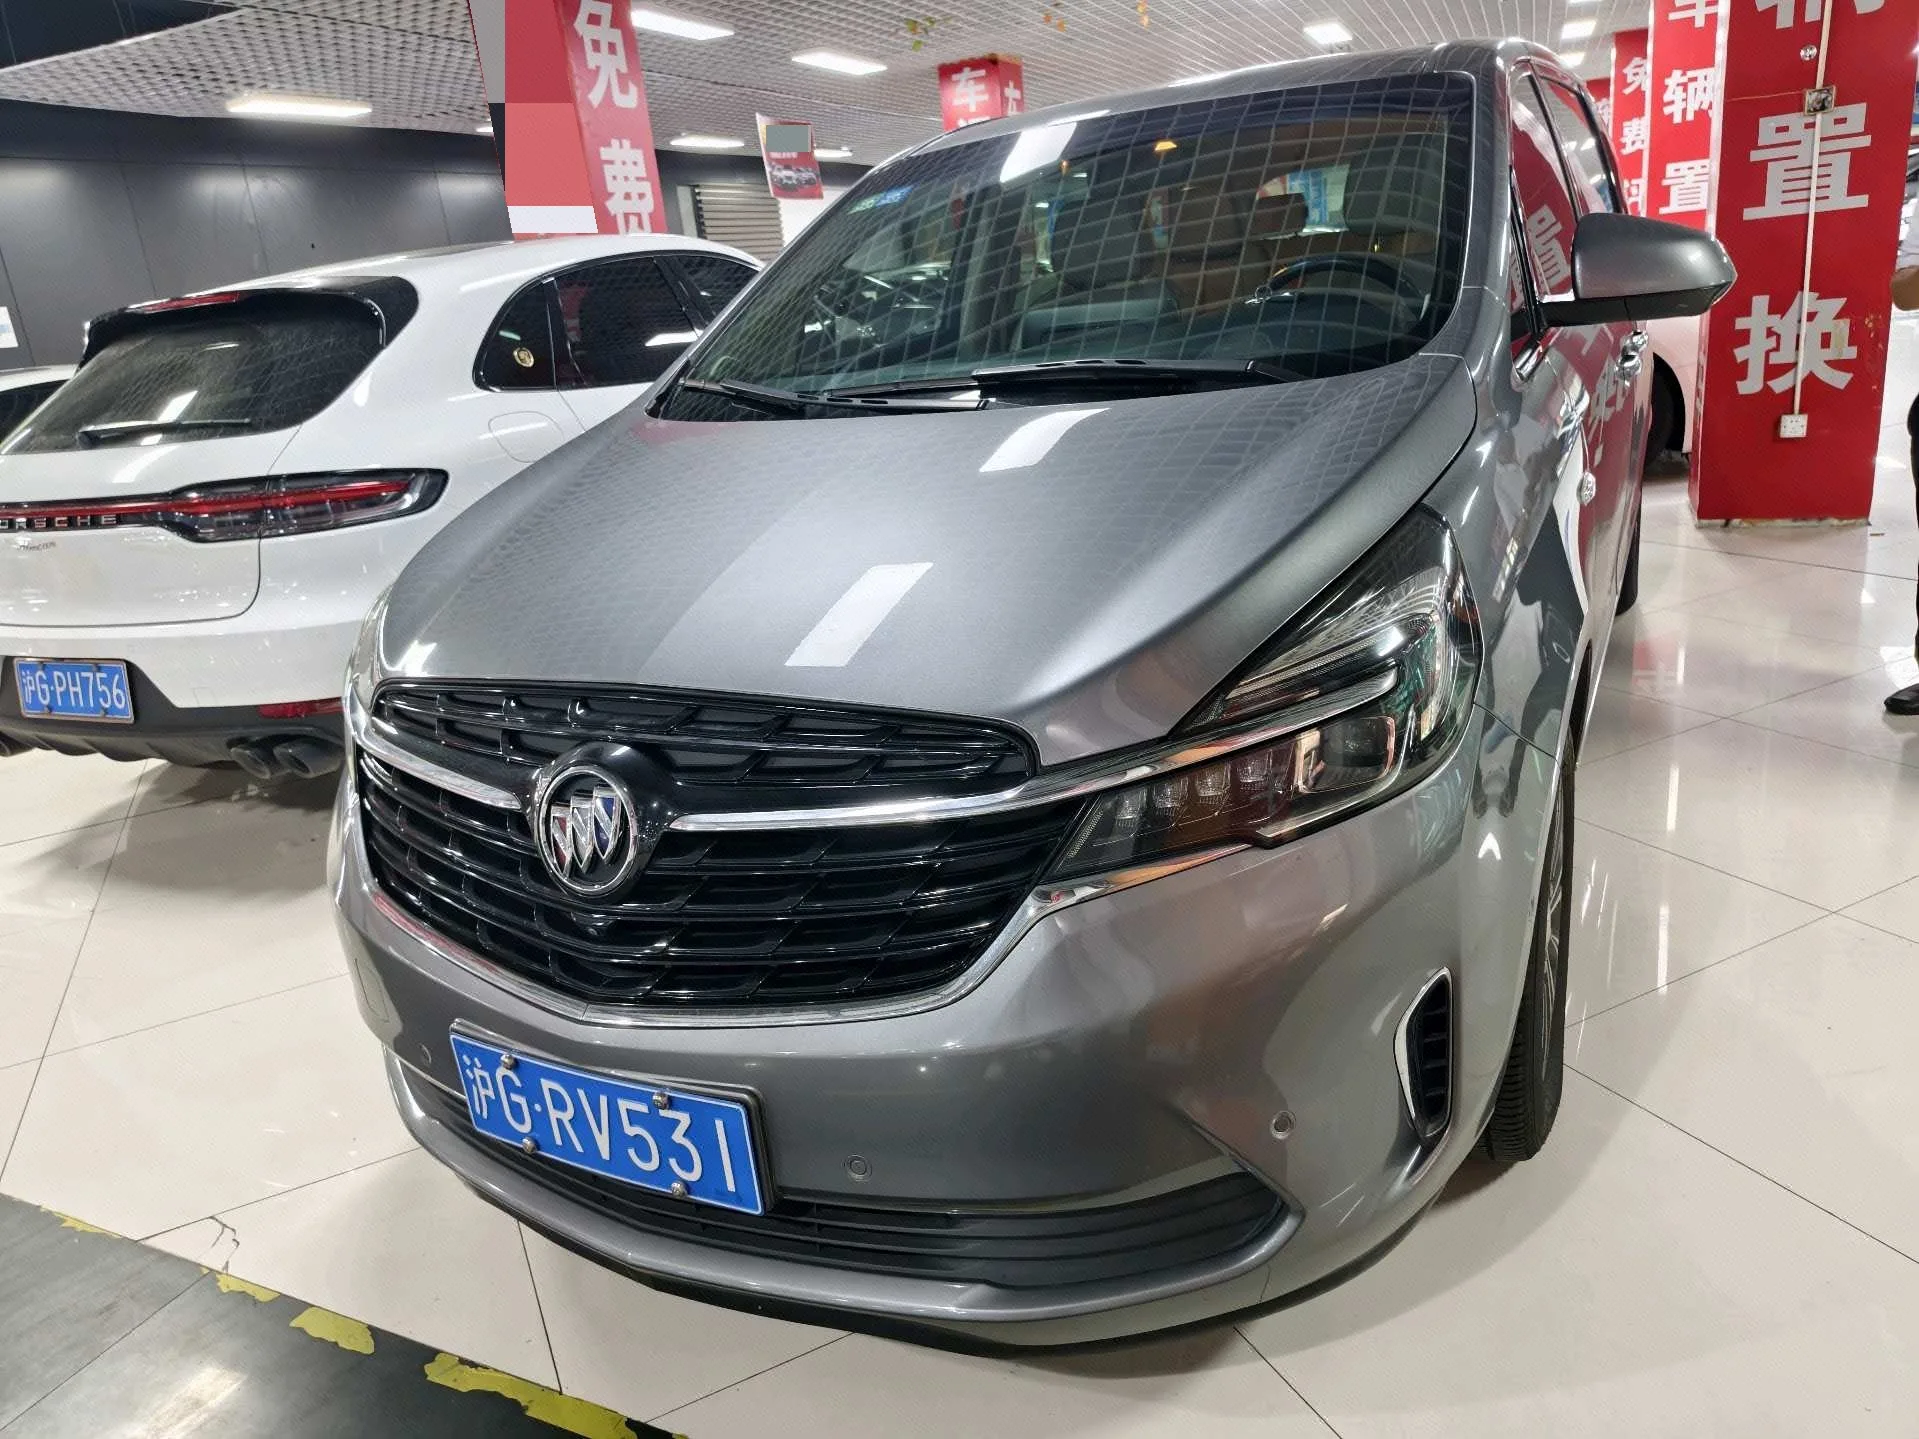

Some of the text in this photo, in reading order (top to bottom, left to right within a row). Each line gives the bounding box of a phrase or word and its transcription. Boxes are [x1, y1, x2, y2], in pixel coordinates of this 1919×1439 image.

[951, 67, 990, 127] 车
[22, 670, 125, 709] 沪G·PH756
[462, 1054, 736, 1193] 沪G·RV531
